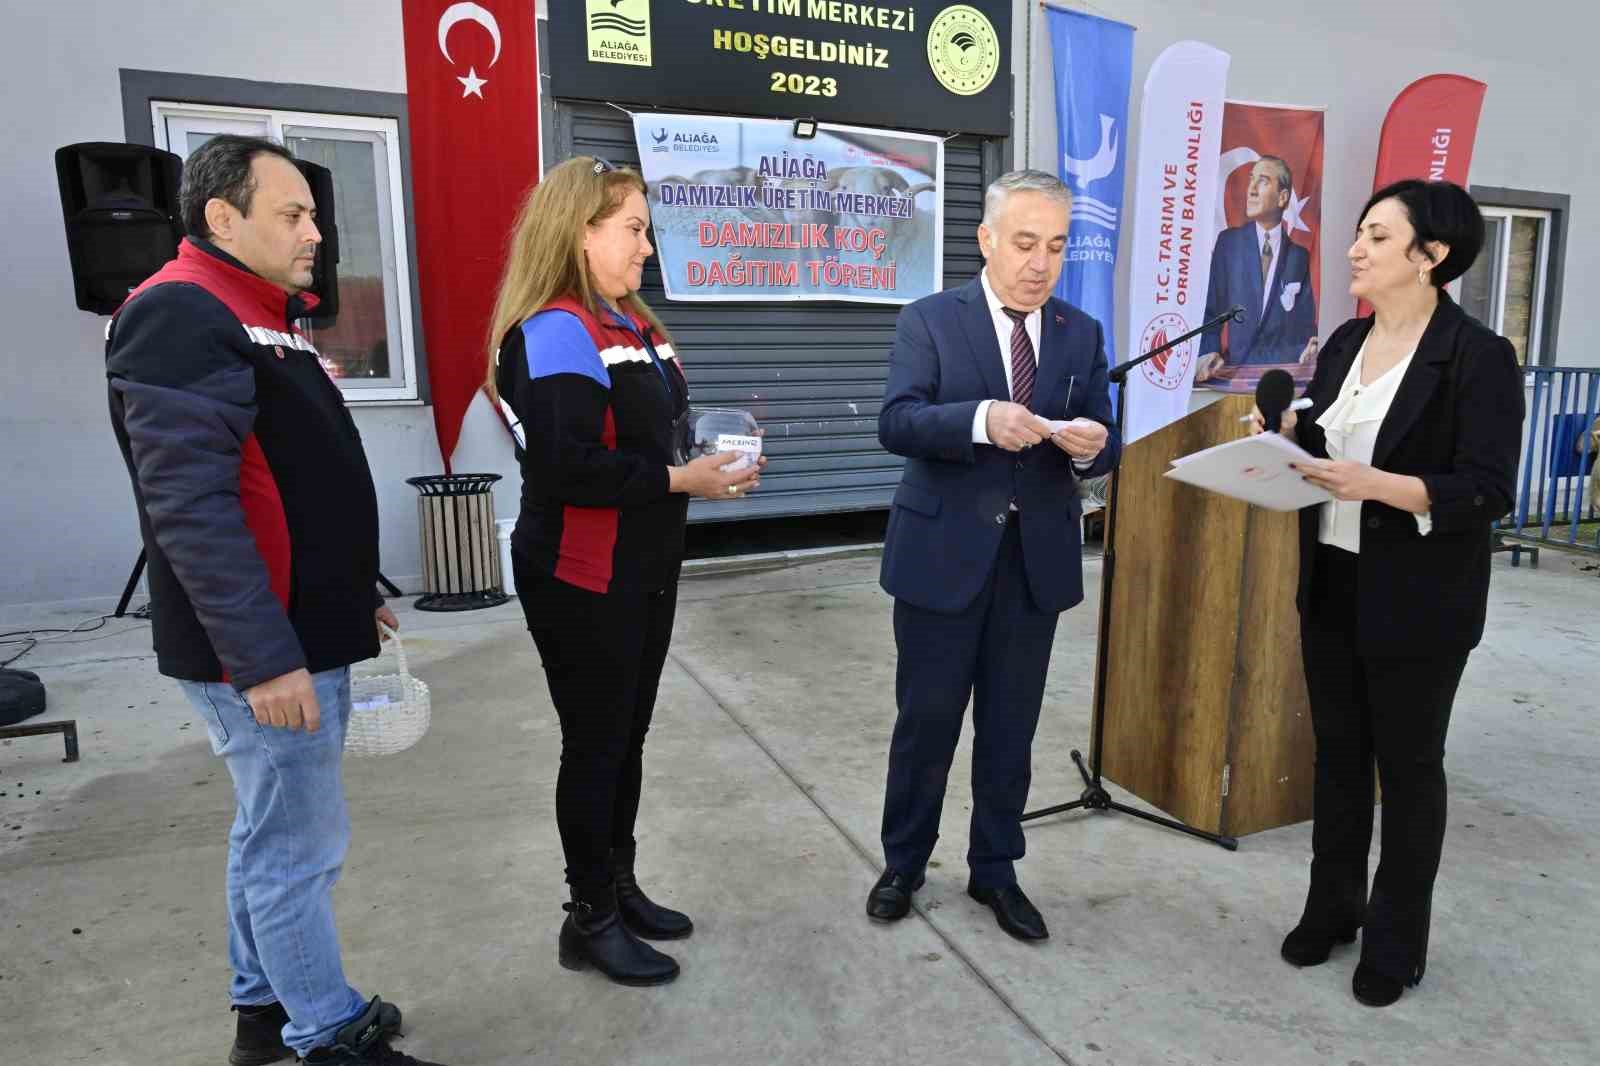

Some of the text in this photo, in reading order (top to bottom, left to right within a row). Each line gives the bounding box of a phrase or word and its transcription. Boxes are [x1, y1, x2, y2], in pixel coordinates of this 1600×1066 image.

[807, 0, 915, 32] MERKEZİ
[713, 29, 889, 69] HOŞGELDİNİZ
[770, 71, 838, 97] 2023
[758, 150, 828, 180] ALİAĞA
[1429, 128, 1452, 181] NLIĞI
[660, 181, 913, 218] DAMIZLIK ÜRETİM MERKEZİ
[1176, 102, 1204, 306] ORMAN BAKANLIĞI
[698, 221, 889, 260] DAMIZLIK KOÇ
[1156, 163, 1178, 305] T.C. TARIM VE
[687, 252, 897, 290] DAĞITIM TÖRENİ
